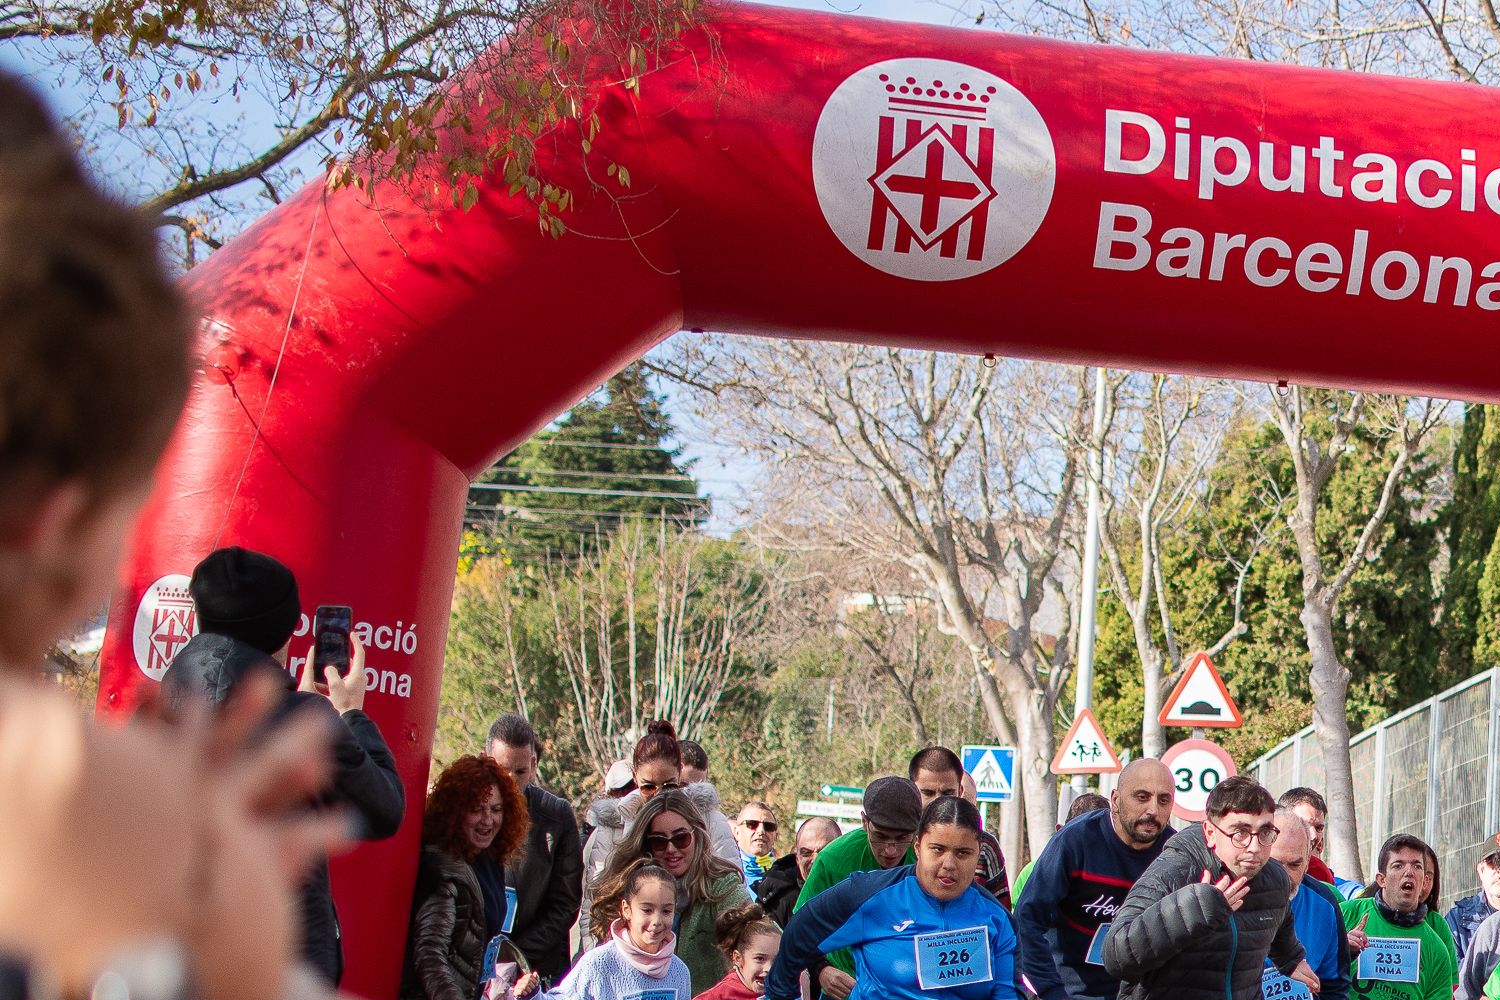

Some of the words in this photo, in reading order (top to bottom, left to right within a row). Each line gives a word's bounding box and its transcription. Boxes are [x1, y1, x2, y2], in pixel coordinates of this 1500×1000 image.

[1174, 767, 1220, 793] 30
[947, 936, 979, 946] INCLUSIVA
[938, 948, 970, 967] 226
[1375, 952, 1402, 965] 233
[938, 966, 974, 980] ANNA
[1375, 965, 1402, 975] INMA
[1265, 980, 1291, 998] 228
